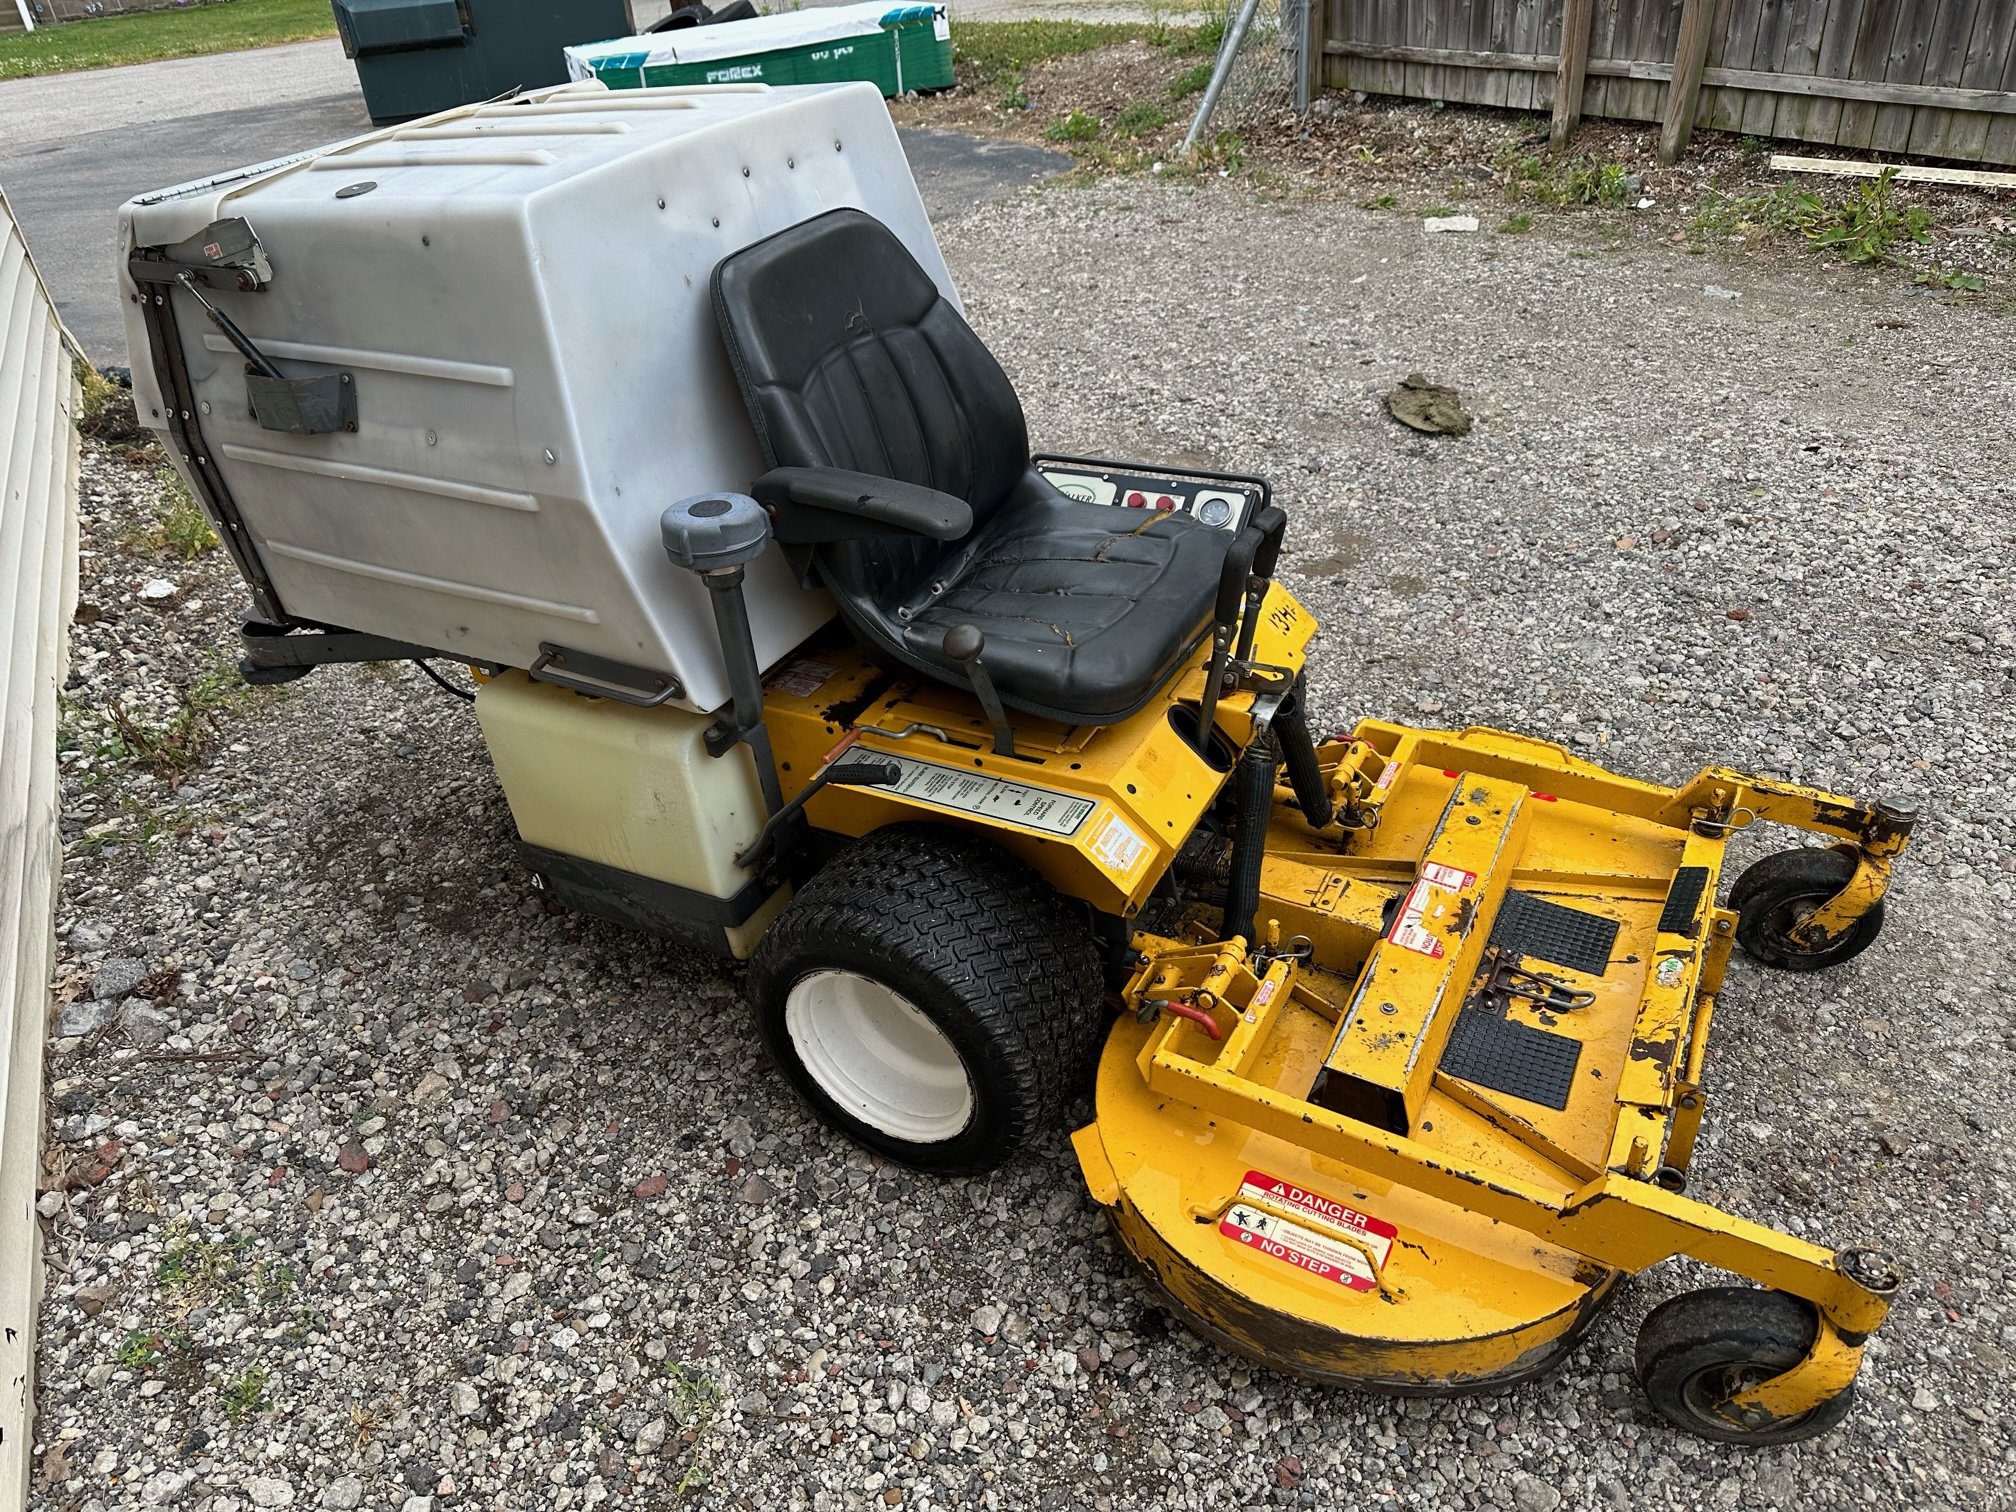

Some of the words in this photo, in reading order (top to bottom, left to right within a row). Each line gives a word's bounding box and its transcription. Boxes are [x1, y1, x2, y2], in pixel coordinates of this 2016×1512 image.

[706, 64, 763, 83] FOREX
[1066, 491, 1093, 503] ALKER
[1023, 796, 1042, 816] CONTROL
[1032, 801, 1047, 815] SPEED
[1036, 799, 1056, 820] FORWARD
[1262, 1190, 1300, 1210] ROTATING
[1301, 1205, 1336, 1224] CUTTING
[1336, 1220, 1367, 1237] BLADES
[1288, 1186, 1368, 1229] DANGER
[1261, 1239, 1286, 1258] NO
[1288, 1251, 1331, 1274] STEP
